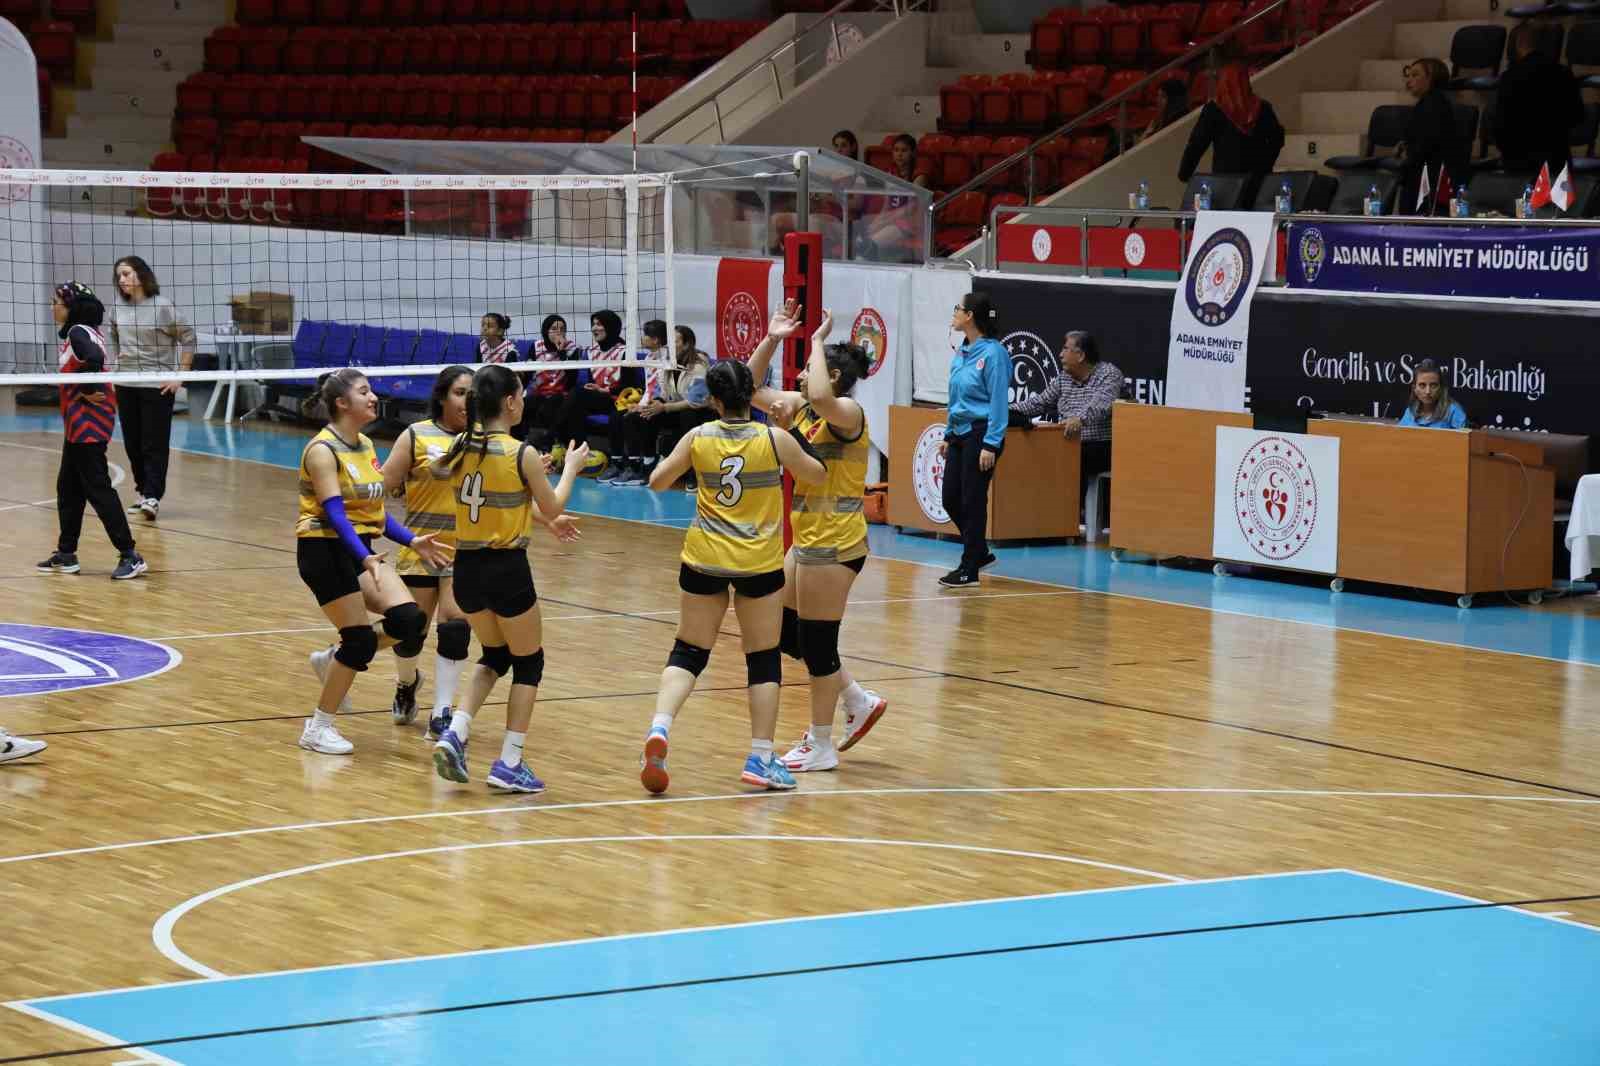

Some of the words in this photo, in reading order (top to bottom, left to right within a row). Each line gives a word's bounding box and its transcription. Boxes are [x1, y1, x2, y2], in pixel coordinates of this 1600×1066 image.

[1004, 41, 1011, 52] D
[914, 102, 921, 114] C
[104, 144, 113, 154] B
[1308, 142, 1316, 154] B
[82, 191, 91, 201] A
[1332, 246, 1382, 266] ADANA
[1385, 242, 1399, 267] İL
[1403, 243, 1474, 269] EMNİYET
[1478, 244, 1589, 272] MÜDÜRLÜĞÜ
[1176, 333, 1206, 346] ADANA
[1207, 336, 1243, 351] EMNİYET
[1183, 347, 1235, 364] MÜDÜRLÜĞÜ
[1303, 347, 1370, 384] Gençlik
[1375, 361, 1396, 383] ve
[1453, 357, 1546, 401] Bakanlığı
[1123, 377, 1164, 405] EN
[715, 454, 746, 508] 3
[460, 470, 487, 524] 4
